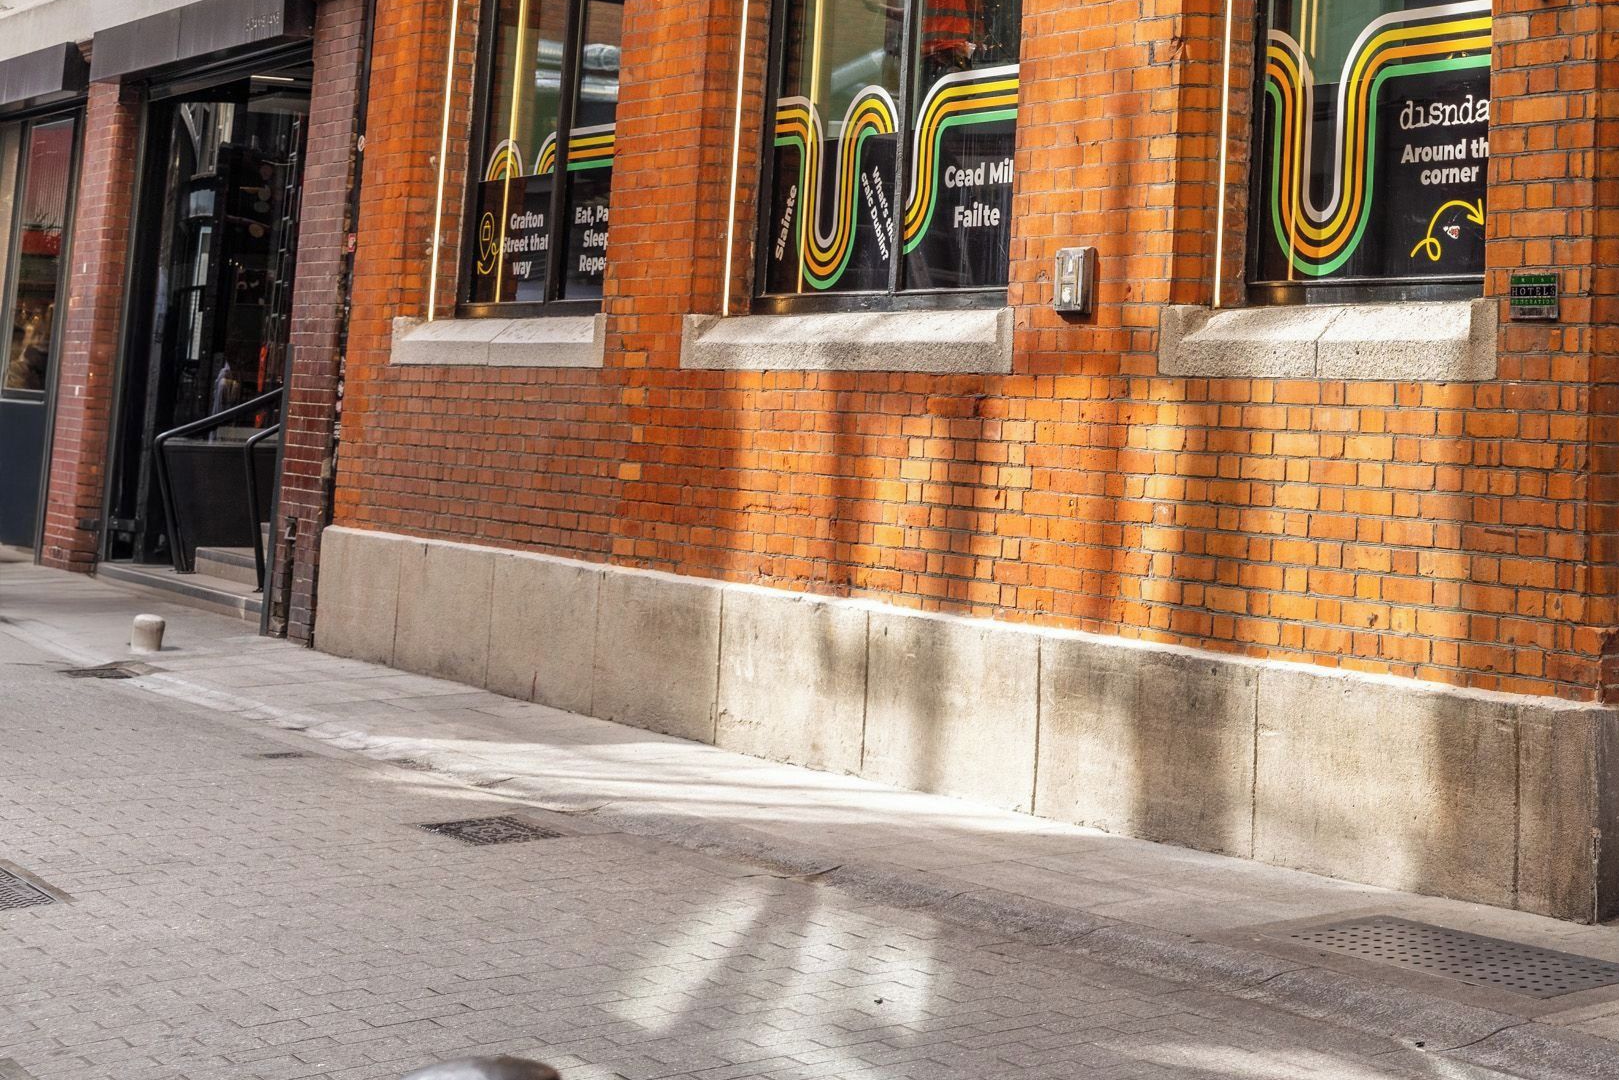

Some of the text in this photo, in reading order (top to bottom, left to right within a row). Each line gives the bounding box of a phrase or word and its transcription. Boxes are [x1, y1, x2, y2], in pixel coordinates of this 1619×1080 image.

[1401, 137, 1489, 164] Around th
[944, 158, 1014, 189] Cead Mil
[1420, 165, 1479, 185] corner
[873, 165, 895, 242] What's th
[510, 211, 544, 230] Grafton
[574, 206, 594, 226] Eat,
[861, 172, 889, 260] craic Dublin?
[953, 201, 1000, 229] Failte
[503, 233, 549, 253] Street that
[513, 261, 532, 279] way
[1511, 287, 1555, 296] HOTELS
